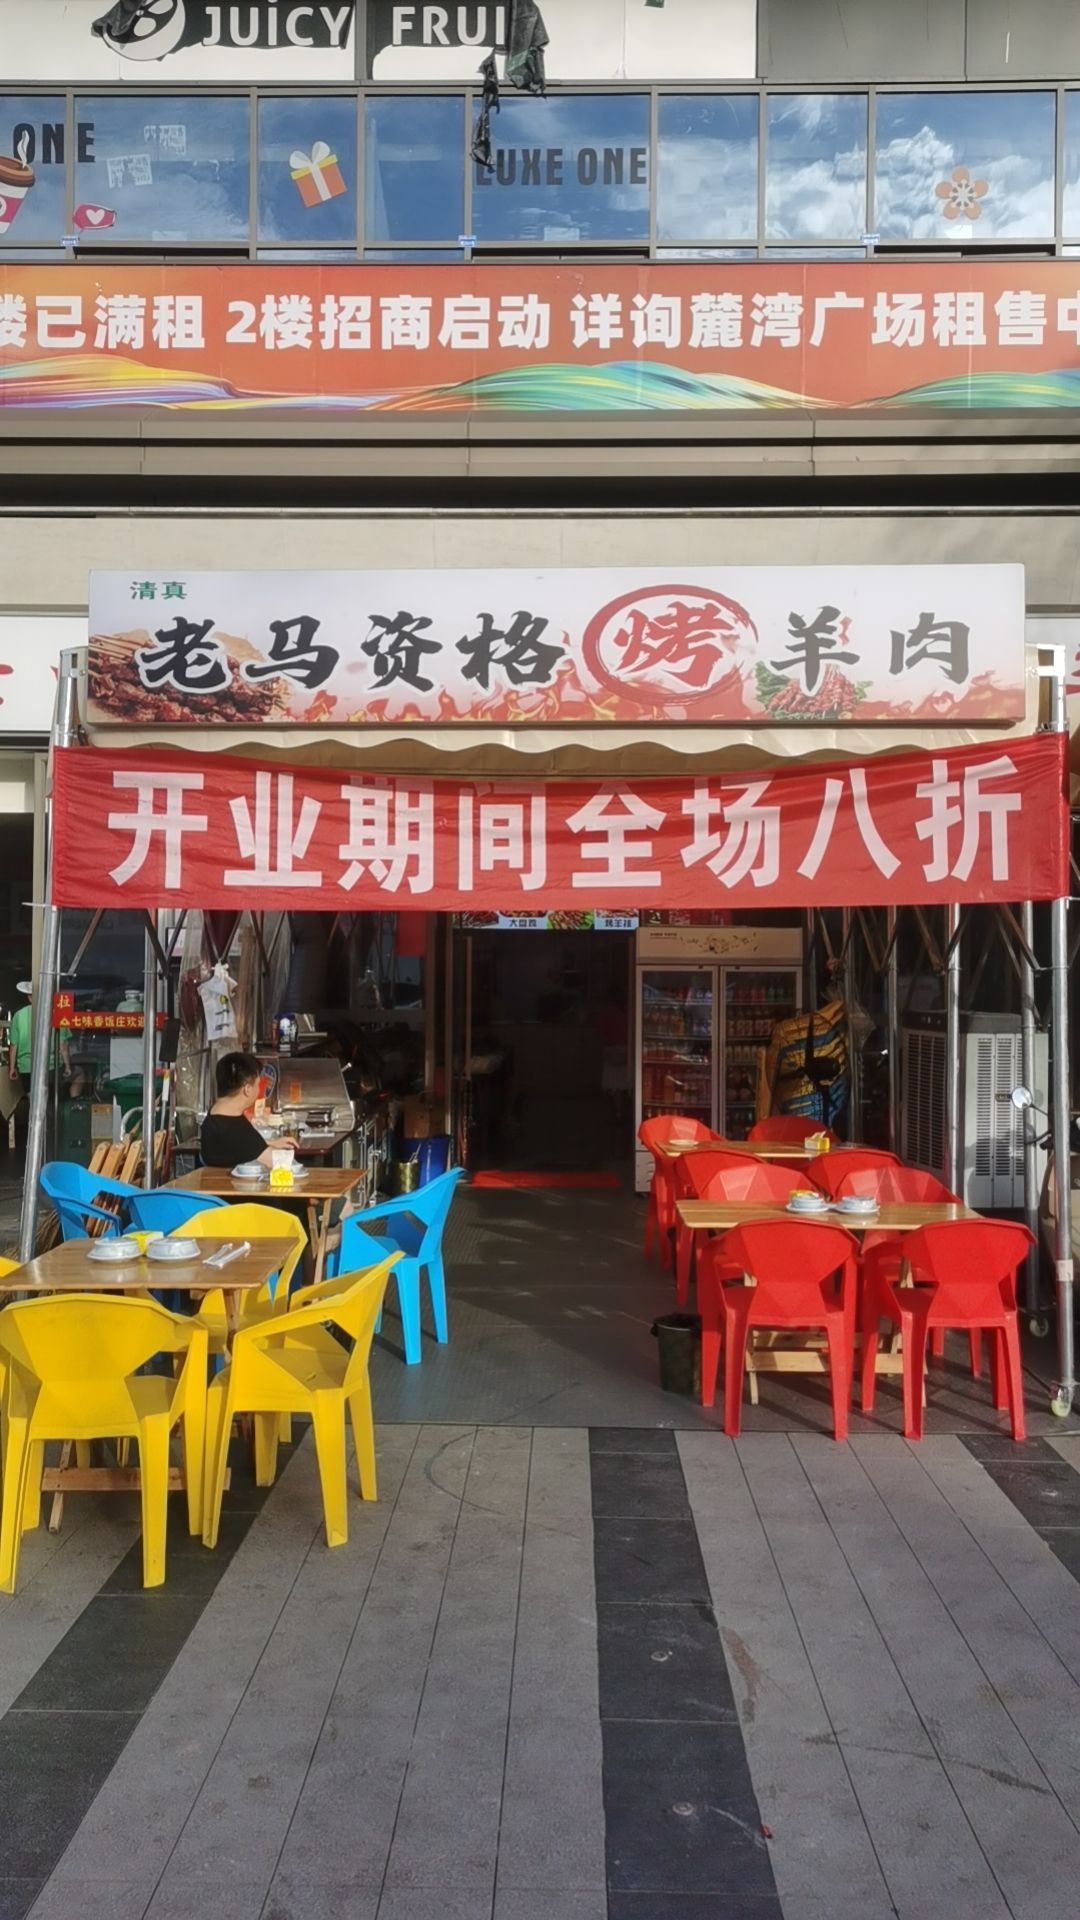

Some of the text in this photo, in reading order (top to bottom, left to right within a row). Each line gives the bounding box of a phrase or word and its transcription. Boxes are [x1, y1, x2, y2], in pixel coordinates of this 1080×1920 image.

[13, 123, 95, 164] ONE
[577, 148, 647, 185] ONE
[226, 294, 550, 350] 2楼招商启动
[130, 581, 187, 600] 清真
[107, 755, 1023, 894] 开业期间全场八折
